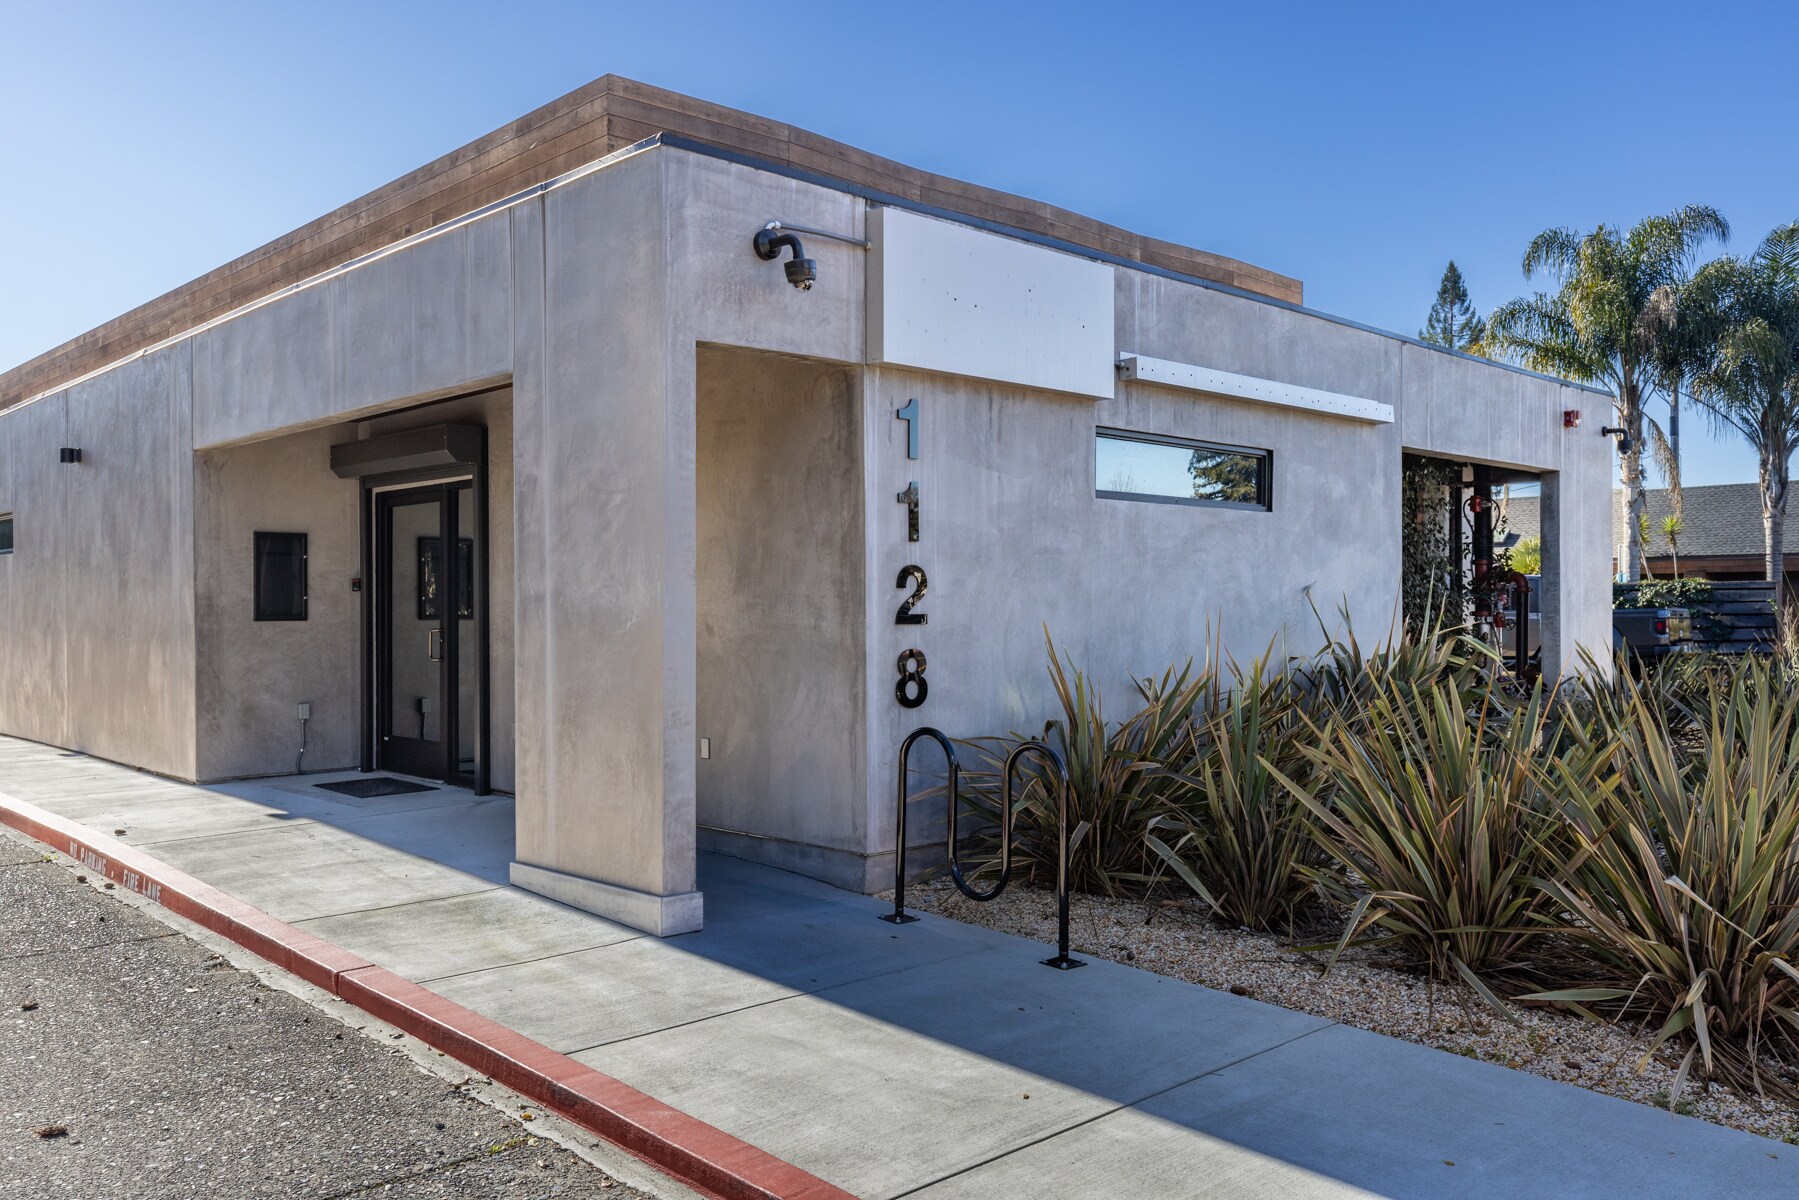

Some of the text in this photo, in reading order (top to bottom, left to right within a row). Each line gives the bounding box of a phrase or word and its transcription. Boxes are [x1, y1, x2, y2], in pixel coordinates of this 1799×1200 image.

[895, 398, 928, 708] 1128
[80, 847, 107, 875] PARKING
[122, 869, 139, 892] FIRE
[142, 877, 161, 902] LANE
